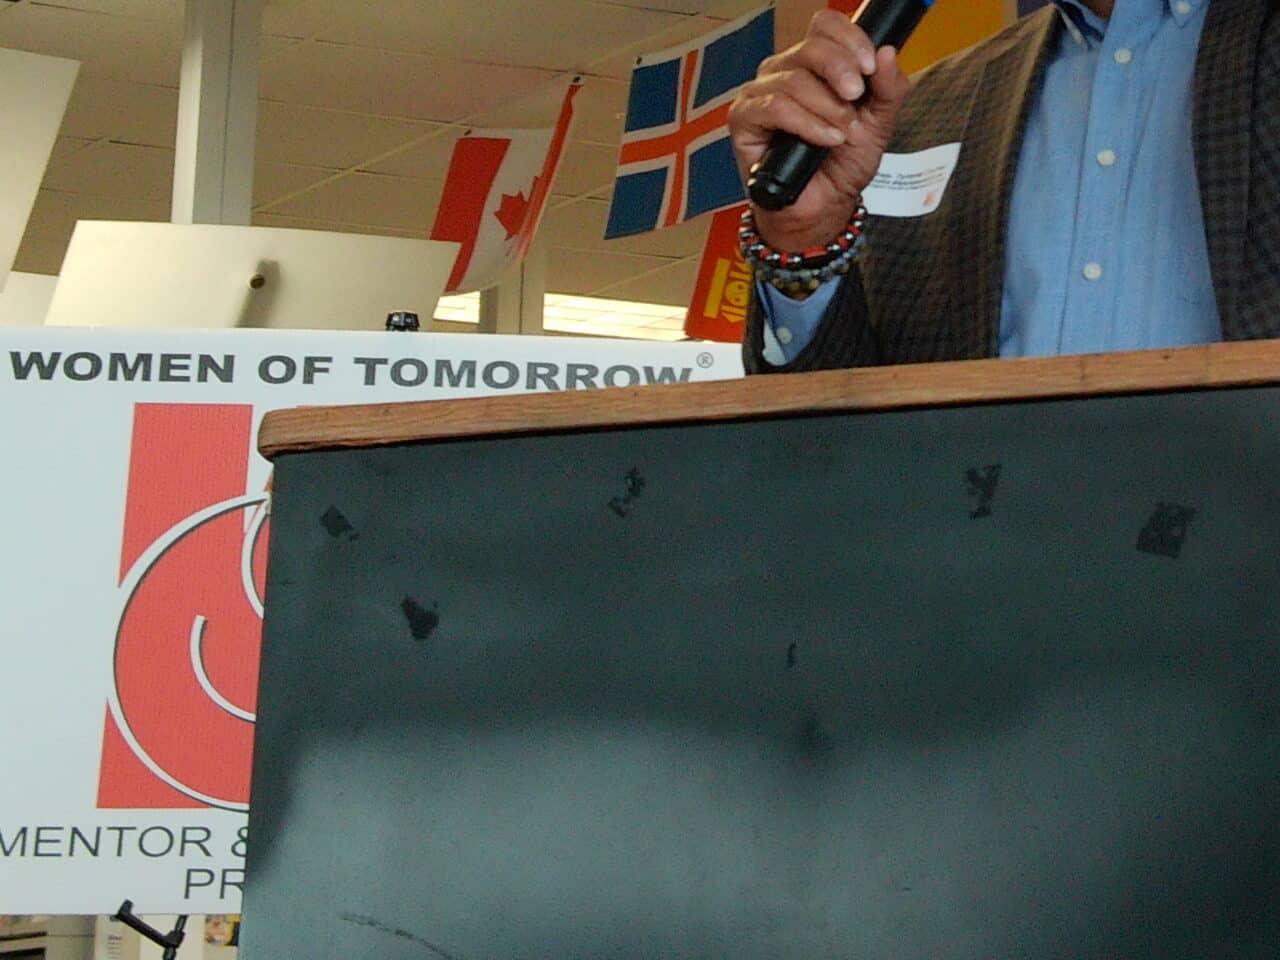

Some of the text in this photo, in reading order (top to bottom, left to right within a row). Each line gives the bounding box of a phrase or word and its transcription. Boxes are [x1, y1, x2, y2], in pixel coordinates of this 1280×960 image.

[10, 351, 235, 383] WOMEN
[258, 355, 333, 385] OF
[0, 826, 213, 858] MENTOR
